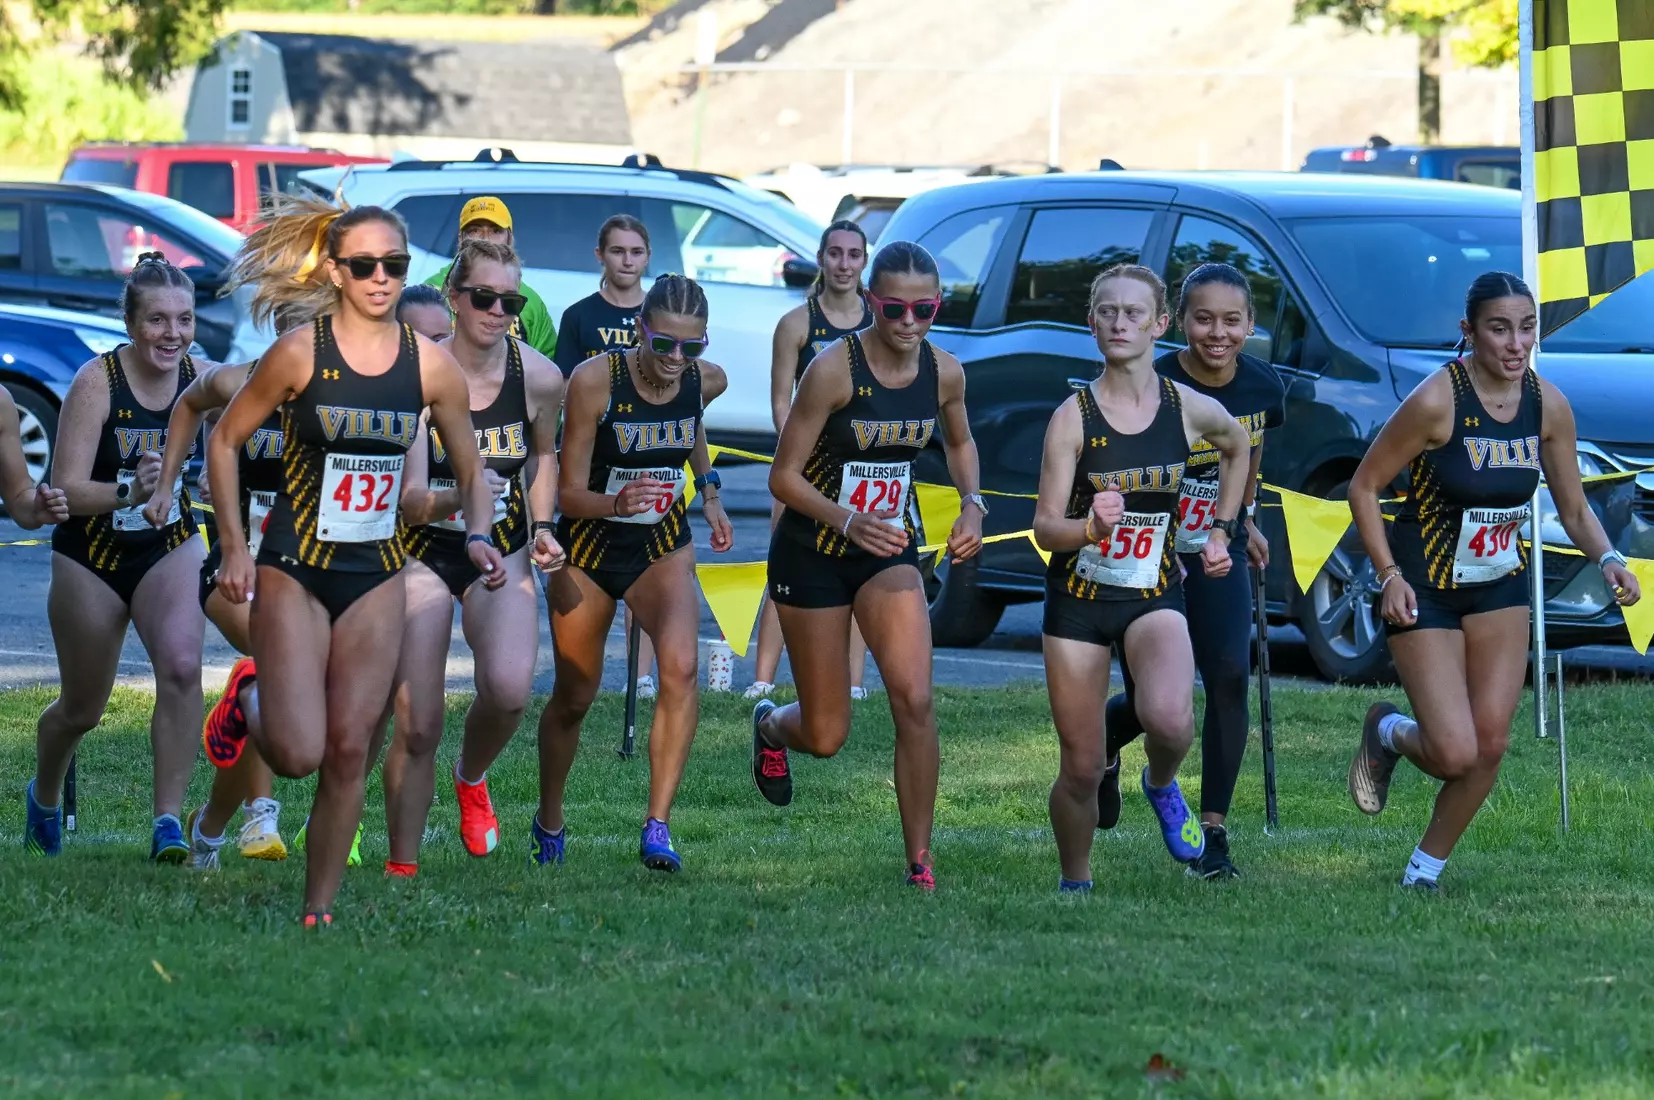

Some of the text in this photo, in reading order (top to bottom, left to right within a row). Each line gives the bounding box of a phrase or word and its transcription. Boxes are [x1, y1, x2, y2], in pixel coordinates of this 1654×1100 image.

[316, 405, 417, 449] VILLE
[430, 422, 527, 463] VLLE
[613, 417, 695, 454] VILLE
[851, 418, 936, 450] VILLE
[332, 457, 401, 472] MILLERSVILLE
[1464, 436, 1540, 471] VILLE
[616, 469, 682, 481] MILLRSVILLE
[849, 465, 906, 480] MILLERSVILLE
[1088, 462, 1185, 494] VILLE
[333, 474, 394, 512] 432
[849, 479, 902, 512] 429
[1469, 508, 1529, 525] MILLERSVILLE
[1468, 521, 1518, 557] 430
